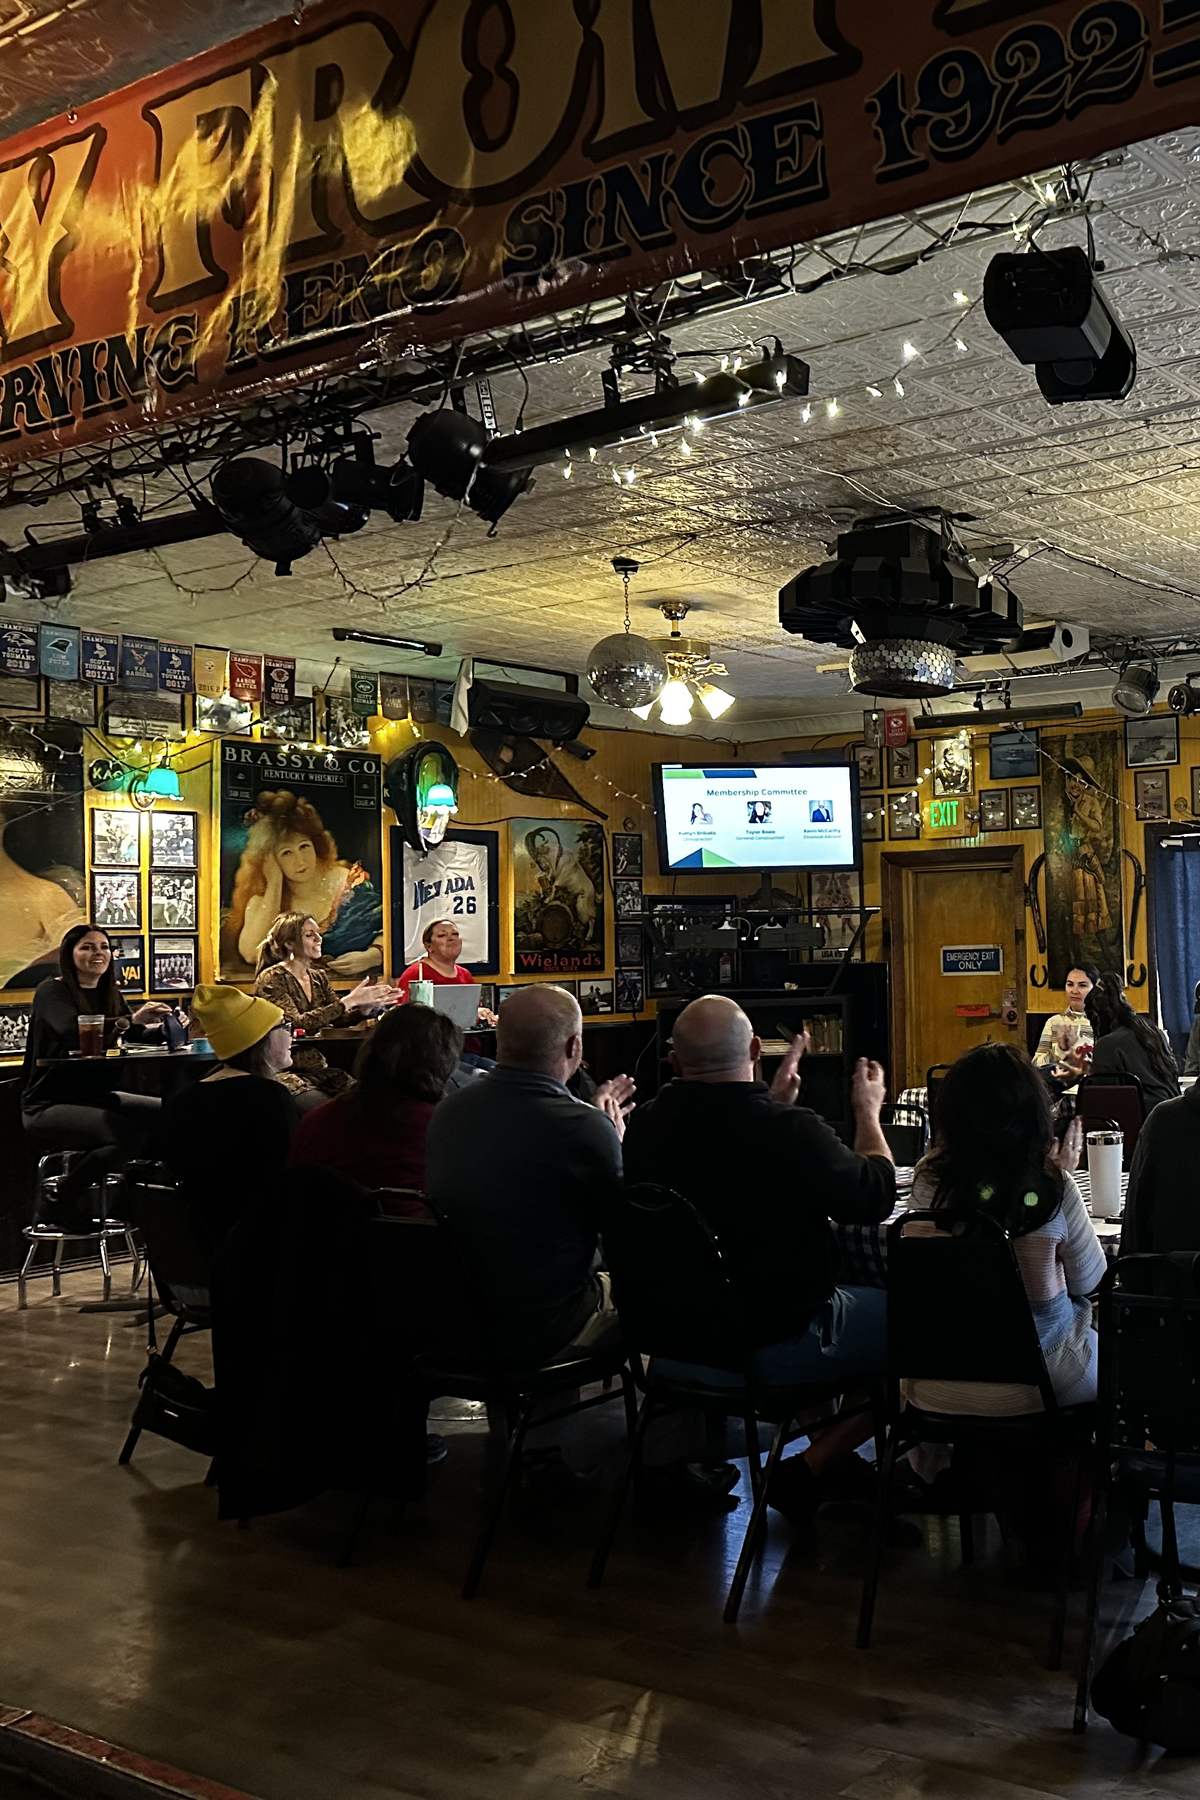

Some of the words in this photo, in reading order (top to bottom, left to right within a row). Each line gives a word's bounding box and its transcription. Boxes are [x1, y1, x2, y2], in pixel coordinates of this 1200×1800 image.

[226, 228, 470, 372] RENO
[502, 101, 829, 276] SINCE
[865, 0, 1150, 184] 1922
[85, 669, 115, 680] 2017.1
[224, 746, 317, 770] BRASSY
[348, 759, 380, 775] CO.
[263, 768, 305, 781] KENTUCKY
[308, 772, 345, 784] WHISKIES
[706, 788, 760, 797] Membership
[761, 788, 808, 796] Committee
[929, 800, 959, 828] EXIT
[453, 896, 477, 915] 26
[520, 953, 601, 967] Wieland's
[946, 951, 980, 962] EMERGENCY
[981, 951, 995, 961] EXIT
[958, 960, 983, 970] ONLY
